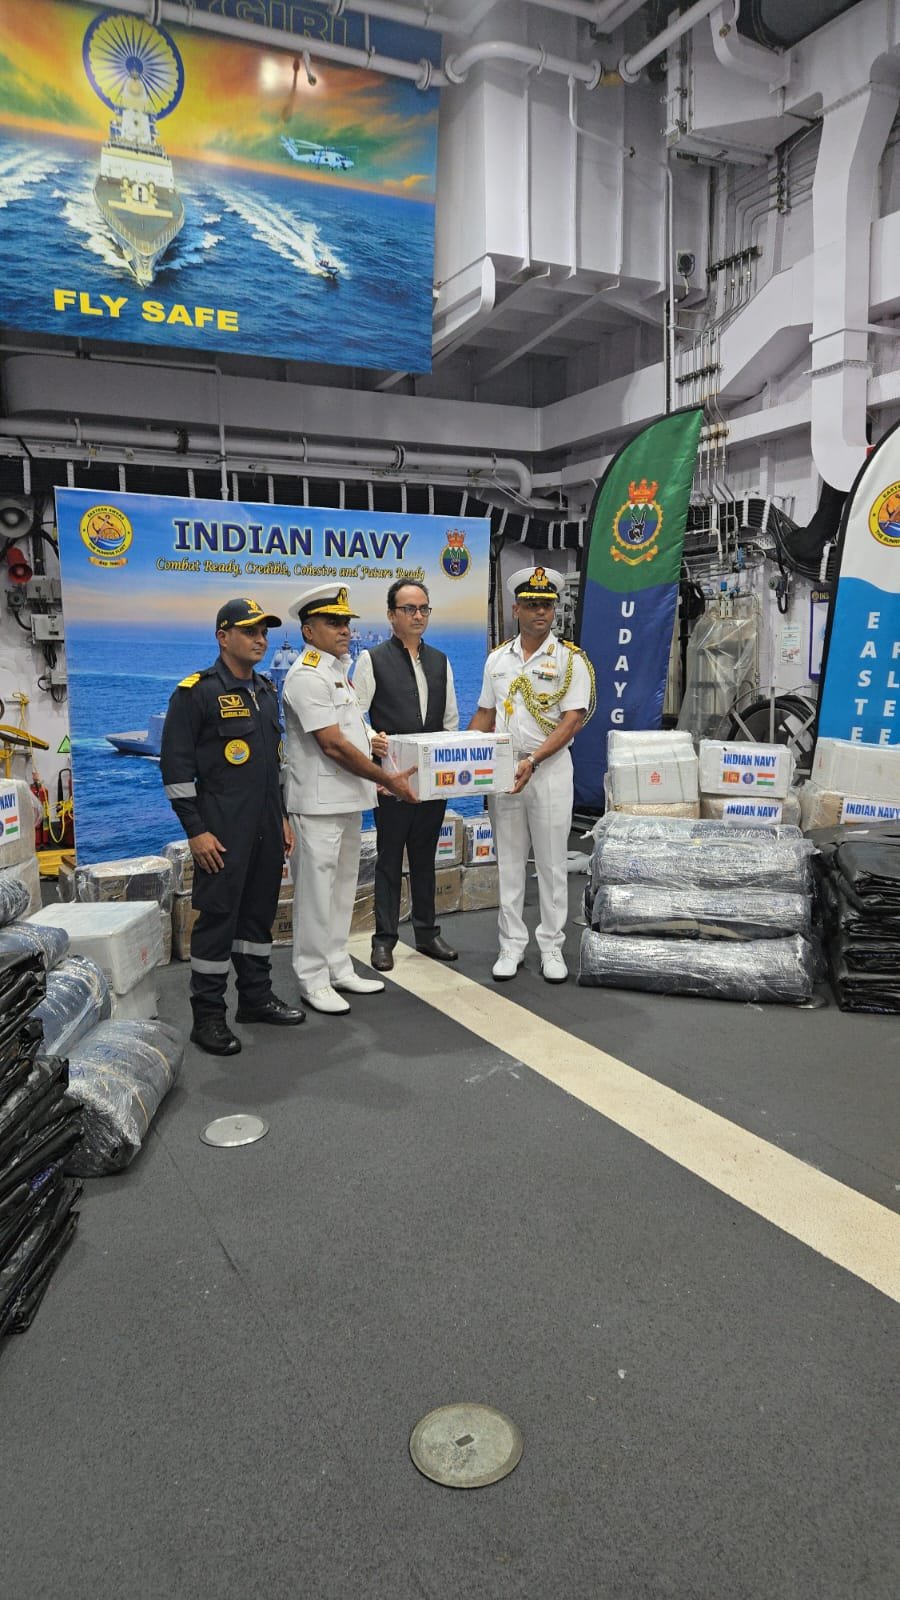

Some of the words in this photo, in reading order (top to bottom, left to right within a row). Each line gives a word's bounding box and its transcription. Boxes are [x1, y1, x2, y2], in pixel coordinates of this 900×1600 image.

[54, 289, 128, 318] FLY
[142, 301, 239, 332] SAFE
[174, 519, 312, 556] INDIAN
[324, 529, 410, 560] NAVY
[156, 556, 201, 572] Combat
[203, 558, 242, 577] Ready,
[245, 561, 291, 577] Credible,
[294, 562, 337, 577] Cohesive
[339, 565, 360, 578] and
[360, 565, 393, 580] Future
[610, 600, 635, 724] UDAYG
[435, 747, 468, 762] INDIAN
[470, 747, 493, 761] NAVY
[724, 754, 753, 766] INDIAN
[754, 755, 777, 767] NAVY
[727, 804, 756, 816] INDIAN
[757, 805, 779, 817] NAVY
[846, 803, 877, 817] INDIAN
